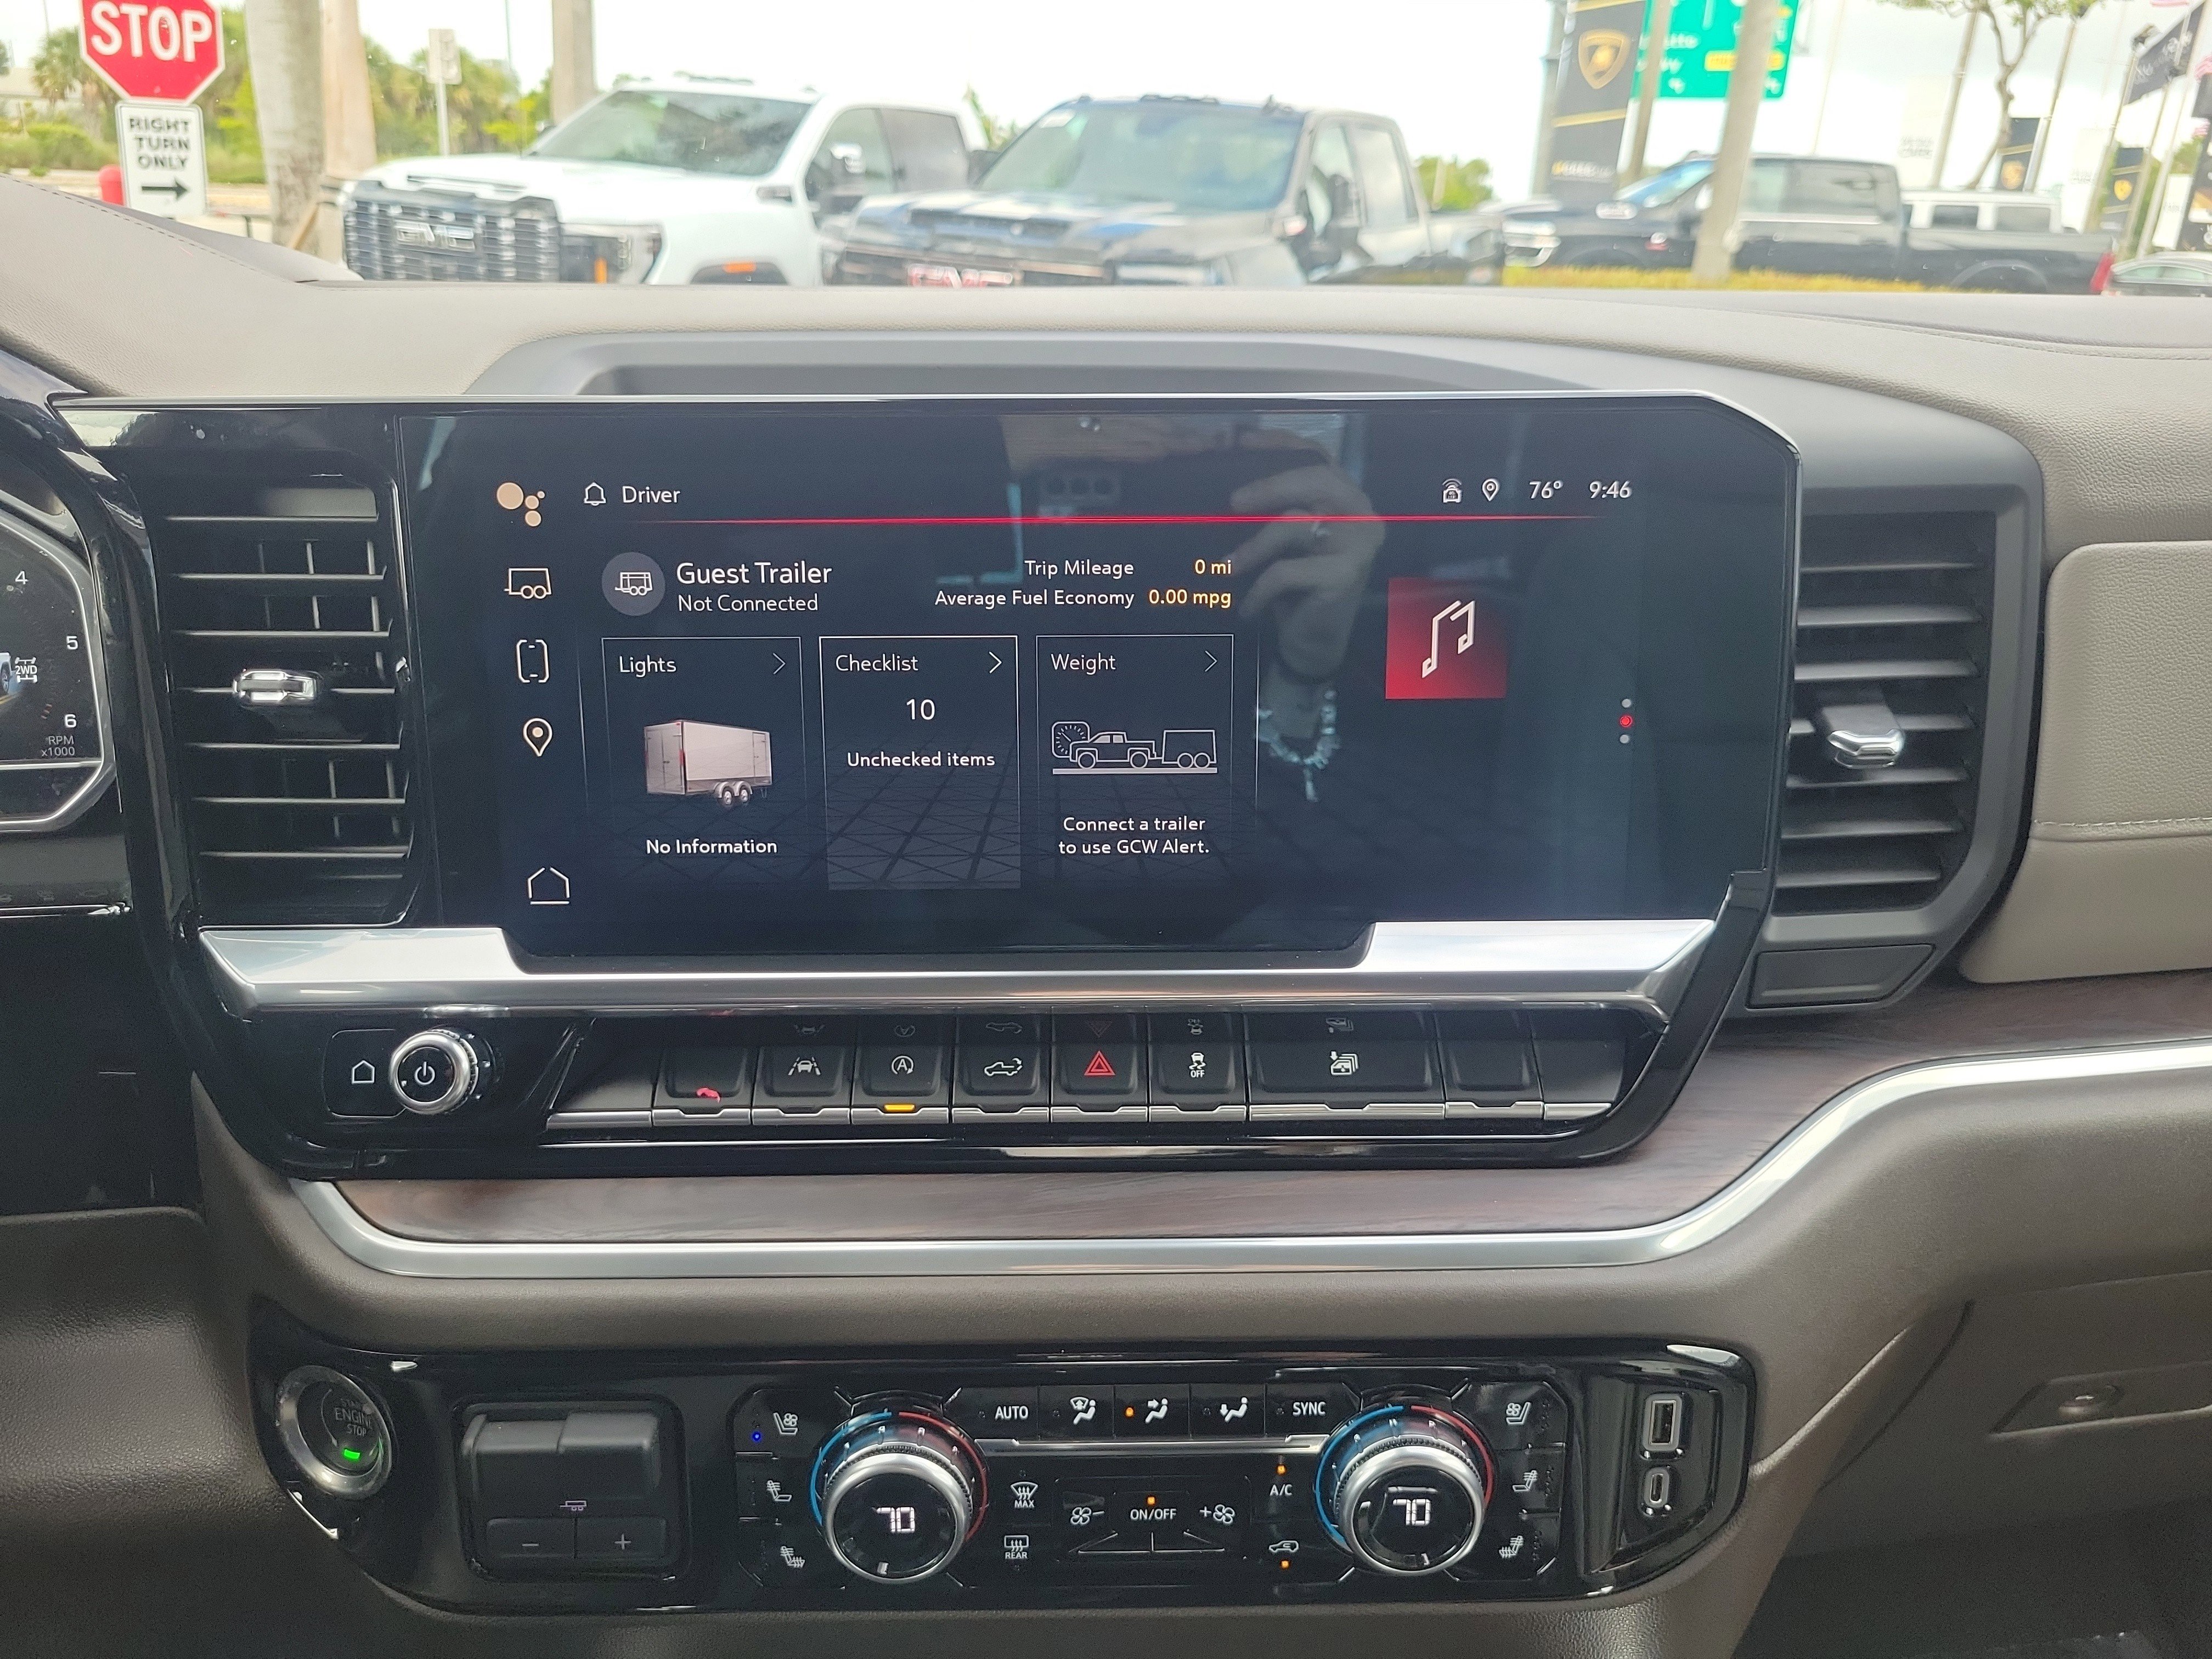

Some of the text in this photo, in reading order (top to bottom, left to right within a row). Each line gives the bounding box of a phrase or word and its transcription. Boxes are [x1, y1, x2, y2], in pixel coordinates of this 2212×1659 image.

[91, 0, 213, 63] STOP
[129, 116, 191, 133] RIGHT
[134, 135, 190, 151] TURN
[138, 154, 189, 170] ONLY
[622, 485, 681, 504] Driver
[1589, 481, 1633, 499] 9:46
[676, 560, 832, 585] Guest Trailer
[1024, 558, 1135, 579] Trip Mileage
[1194, 558, 1232, 574] 0 mi
[15, 571, 28, 585] 4
[678, 592, 819, 612] Not Connected
[934, 589, 1136, 610] Average Fuel Economy
[1148, 589, 1232, 608] 0.00 mpg
[66, 636, 78, 651] 5
[15, 664, 38, 675] 2WD
[618, 655, 677, 679] Lights
[835, 653, 919, 672] Checklist
[1051, 653, 1116, 675] Weight
[906, 698, 935, 721] 10
[64, 714, 77, 729] 6
[48, 735, 75, 745] RPM
[41, 747, 75, 757] x1000
[847, 752, 996, 768] Unchecked items
[1063, 816, 1206, 833] Connect a trailer
[646, 838, 778, 855] No Information
[1058, 839, 1210, 855] to use GCW Alert.
[896, 1059, 908, 1071] A
[1190, 1070, 1205, 1078] OFF
[995, 1406, 1029, 1420] AUTO
[1293, 1402, 1327, 1416] SYNC
[346, 1423, 366, 1437] STOP
[1269, 1483, 1293, 1496] A/C
[1014, 1499, 1035, 1508] MAX
[875, 1506, 916, 1533] 70
[1130, 1508, 1177, 1521] ON/OFF
[1392, 1498, 1431, 1526] 70
[1005, 1550, 1028, 1560] REAR
